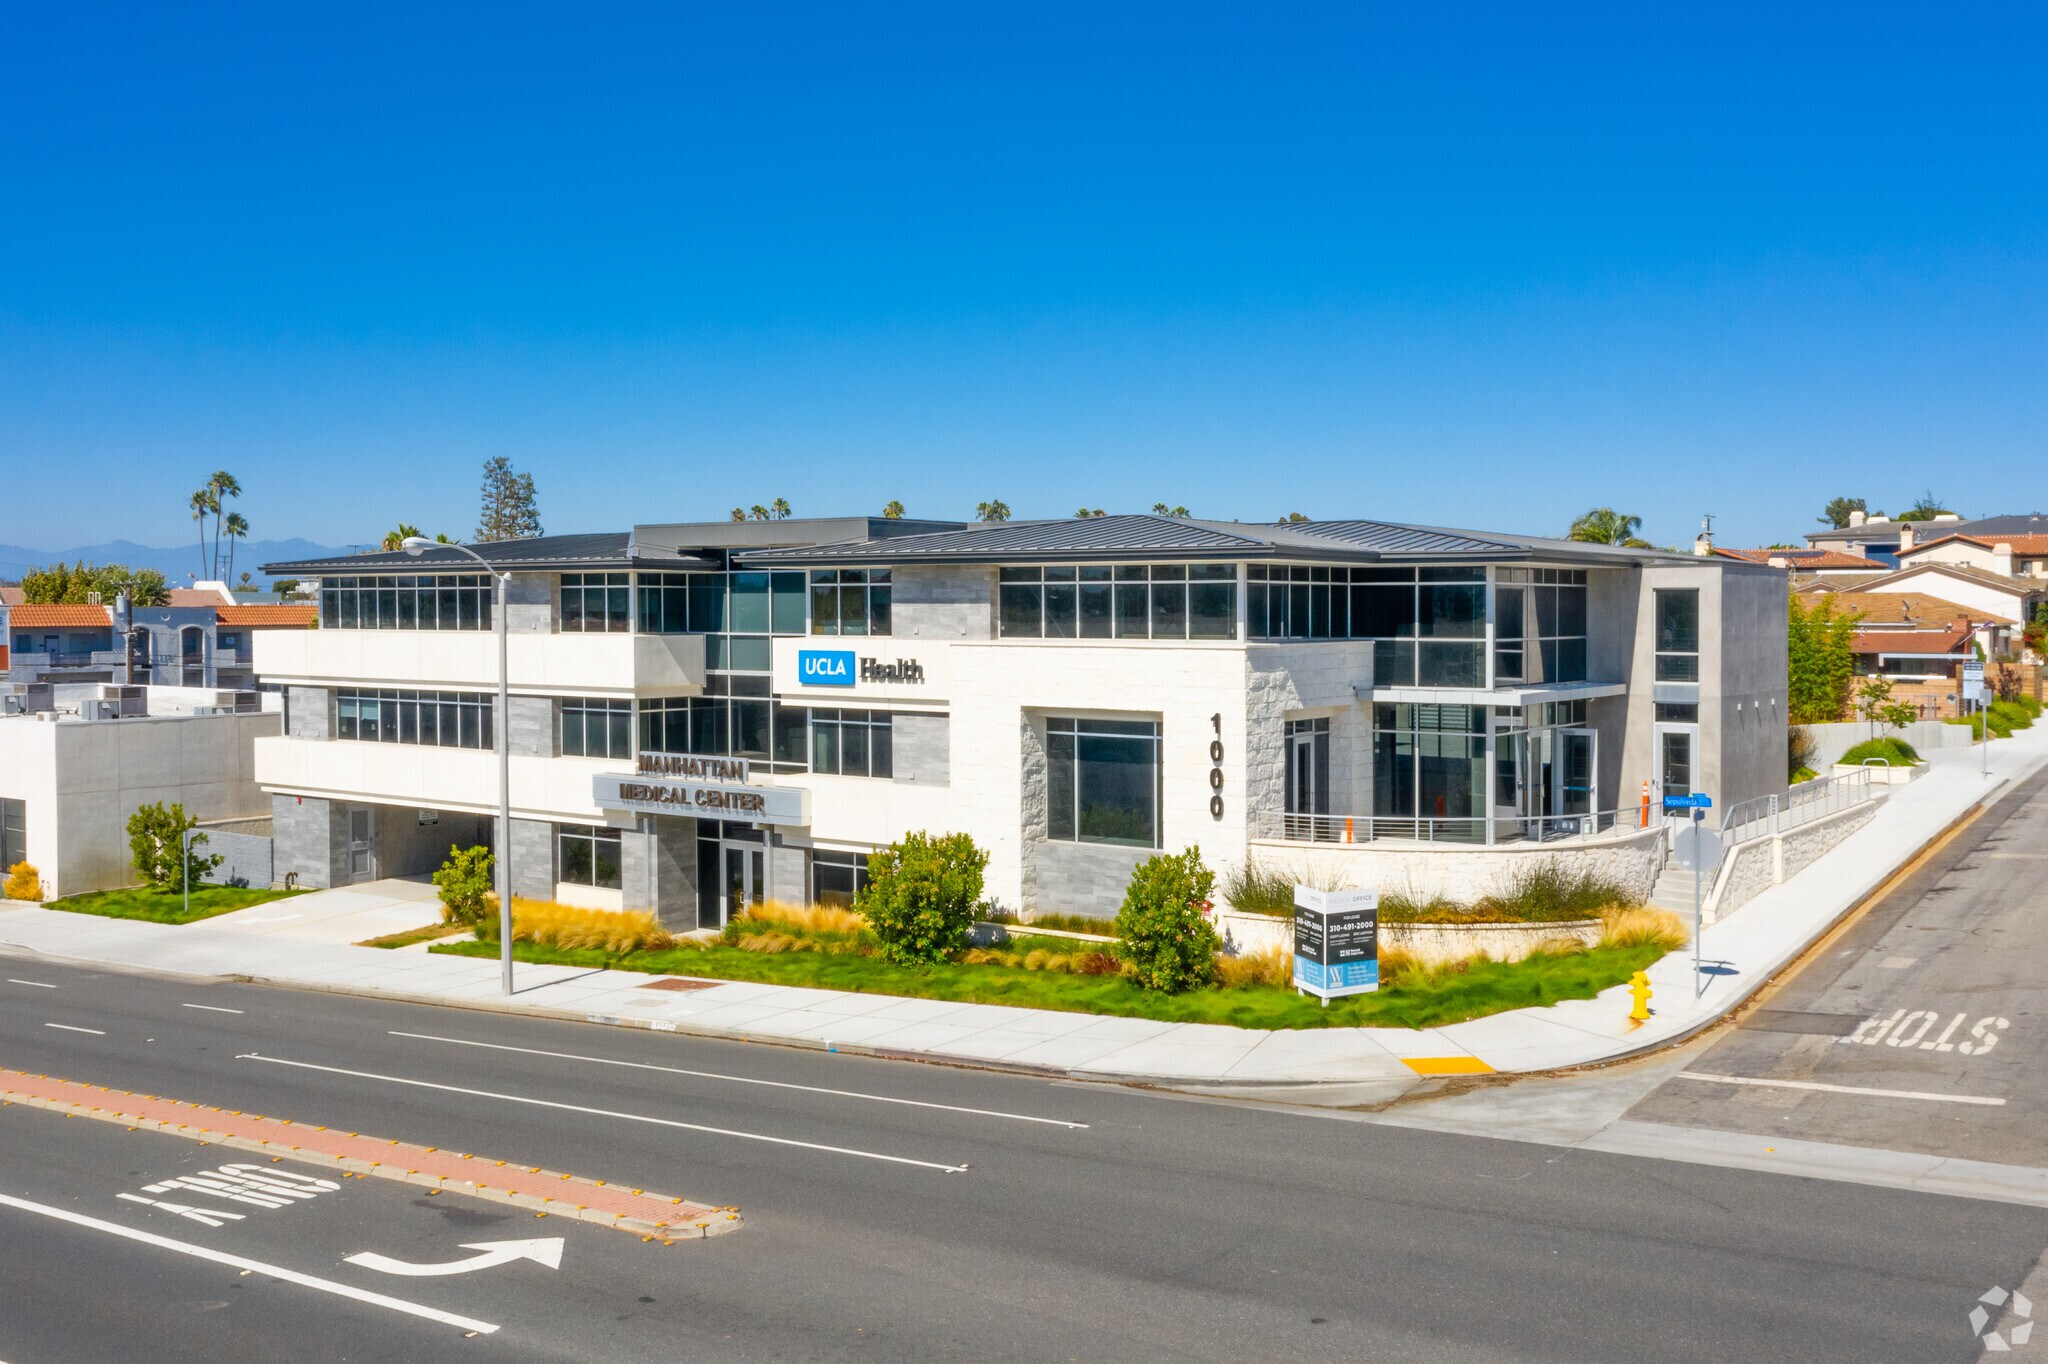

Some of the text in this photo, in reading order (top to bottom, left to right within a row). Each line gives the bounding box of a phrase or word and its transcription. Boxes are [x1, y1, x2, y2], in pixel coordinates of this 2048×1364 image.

[805, 657, 924, 681] UCLA Health
[638, 755, 744, 779] MANHATTAN
[1209, 712, 1224, 819] 1000
[619, 783, 766, 812] MEDICAL CENTER
[1665, 798, 1697, 806] Sepulveda
[1851, 1008, 2010, 1056] STOP
[115, 1163, 341, 1227] ONLY
